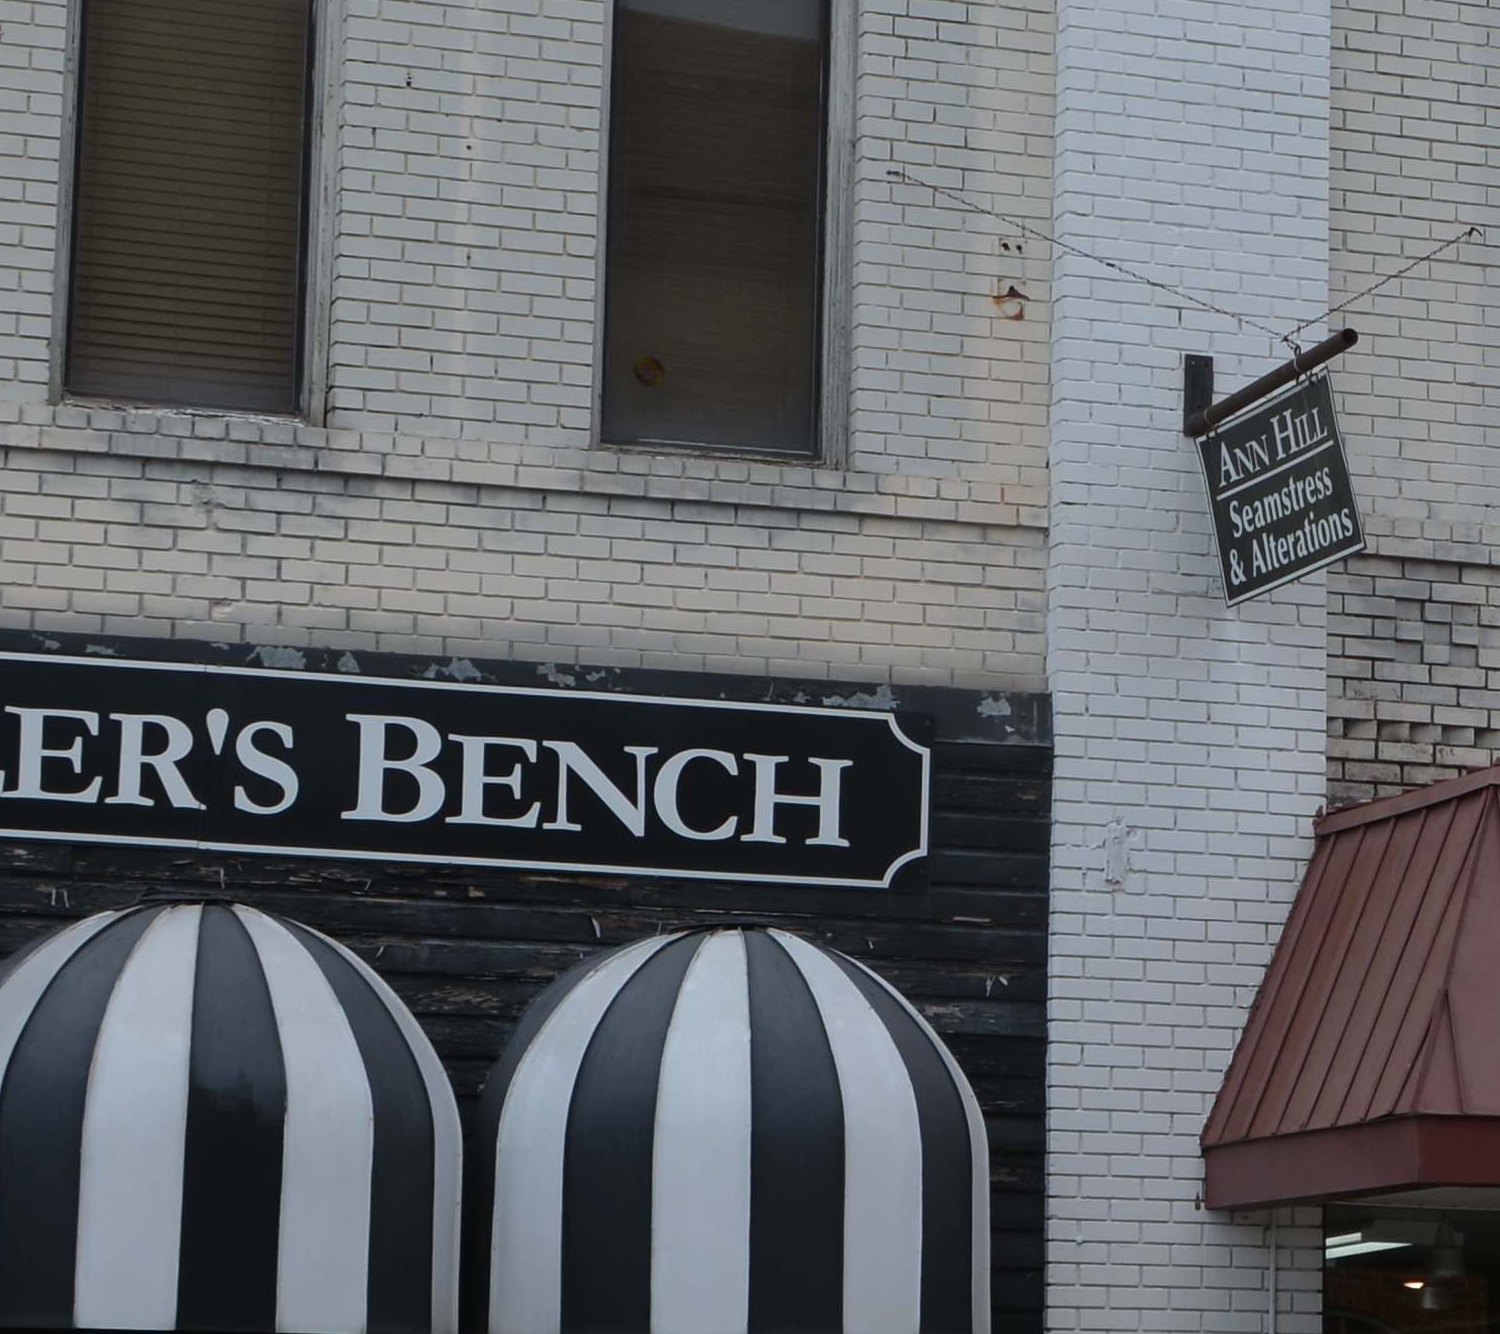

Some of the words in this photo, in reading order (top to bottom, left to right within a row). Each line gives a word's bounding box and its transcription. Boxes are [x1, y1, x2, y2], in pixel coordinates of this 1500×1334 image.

[1218, 434, 1271, 489] ANN
[1269, 407, 1328, 462] HILL
[1229, 466, 1333, 538] Seamstress
[1229, 548, 1247, 586] &
[1252, 507, 1353, 578] Alterations
[340, 713, 854, 848] BENCH
